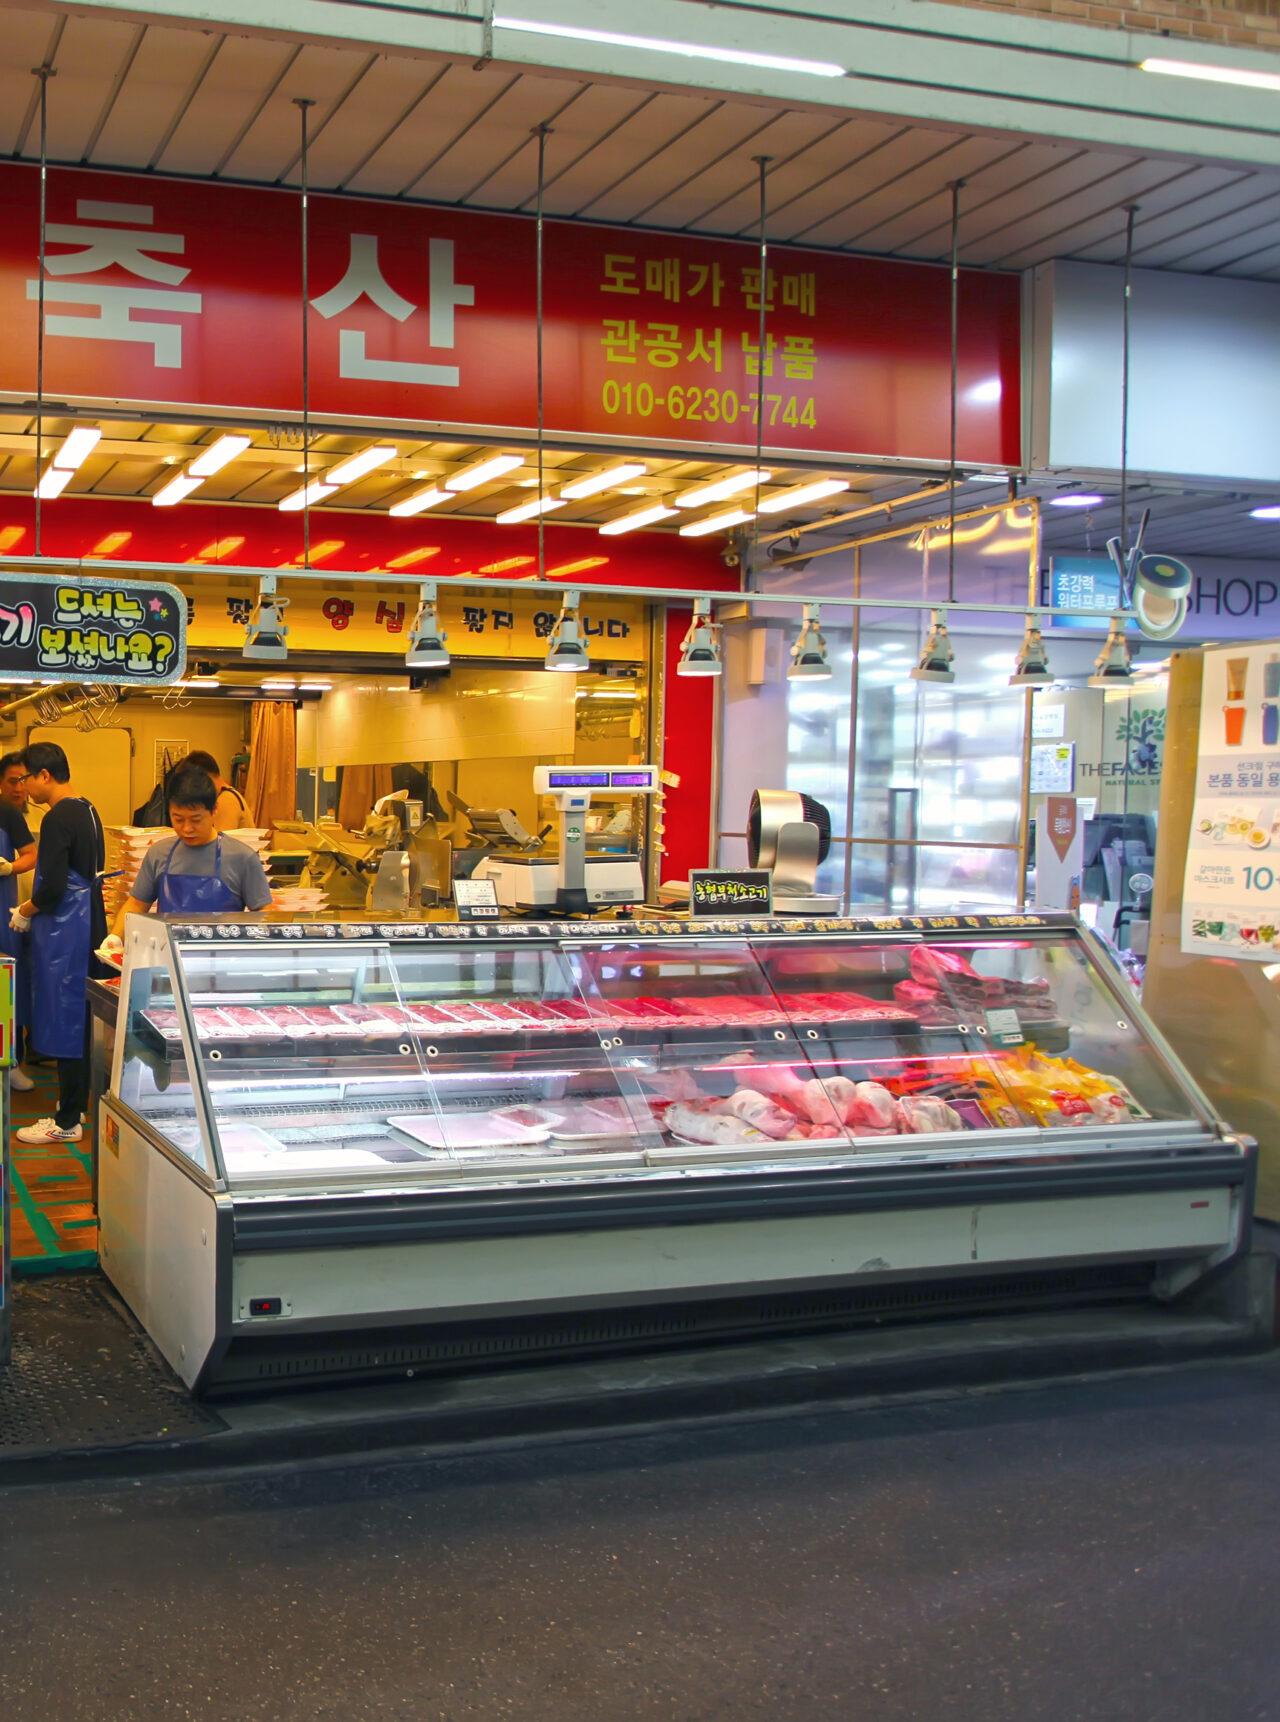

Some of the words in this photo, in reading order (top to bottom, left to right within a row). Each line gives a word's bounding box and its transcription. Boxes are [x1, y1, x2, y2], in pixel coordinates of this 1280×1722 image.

[600, 254, 725, 307] 도매가
[741, 267, 816, 316] 판매
[600, 319, 723, 373] 관공서
[741, 331, 817, 380] 납품
[602, 379, 817, 430] 010-6230-7744
[1057, 574, 1095, 593] 초강력
[463, 606, 514, 633] 팔지
[533, 610, 631, 640] 않니다
[38, 628, 174, 676] 보셨나요?
[1207, 773, 1233, 789] 본품
[1236, 773, 1264, 789] 동일
